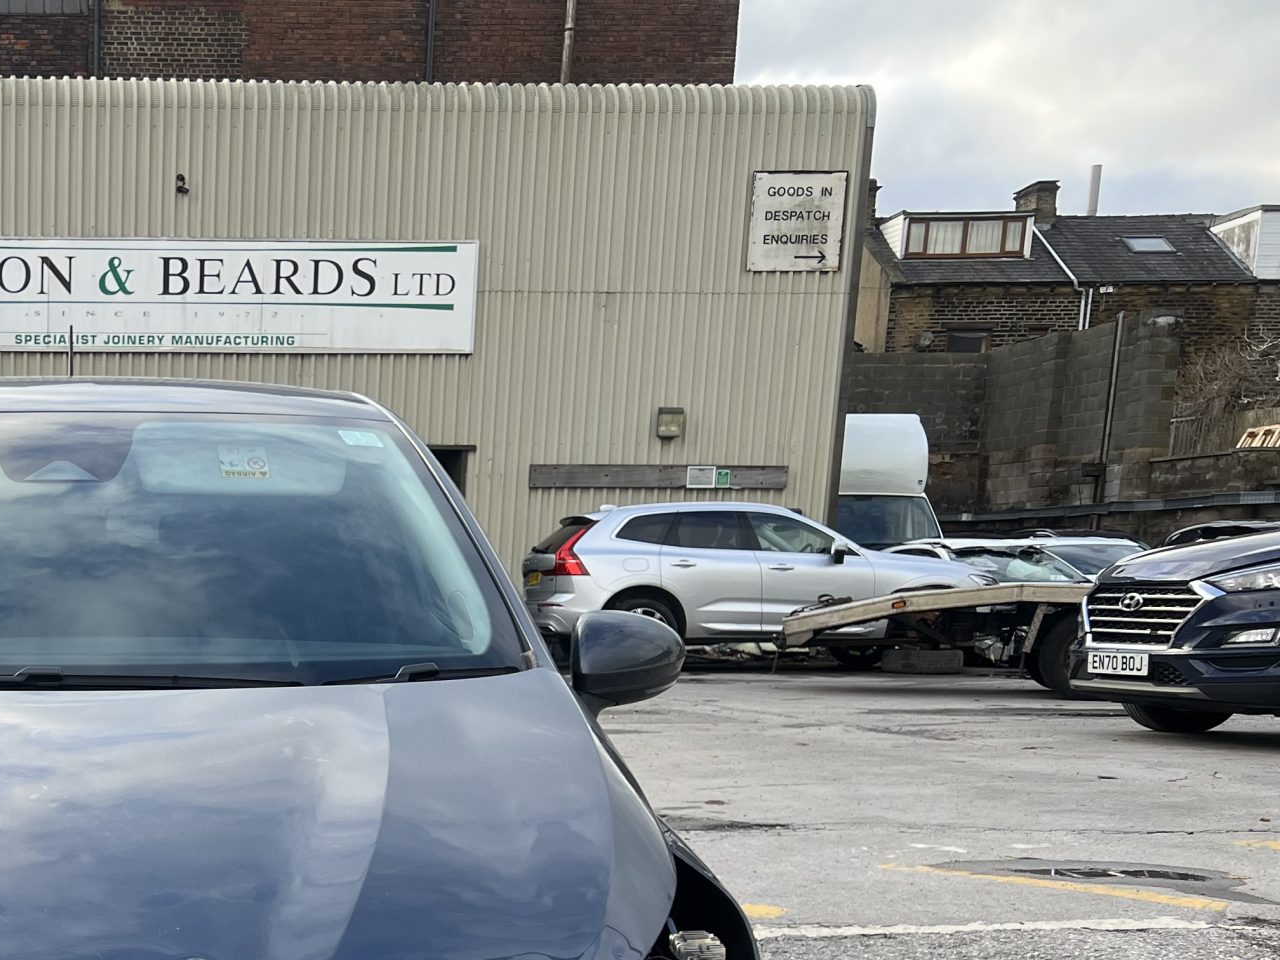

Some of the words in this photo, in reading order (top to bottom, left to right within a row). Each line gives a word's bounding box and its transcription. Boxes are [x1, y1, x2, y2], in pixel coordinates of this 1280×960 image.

[767, 186, 814, 197] GOODS
[821, 186, 833, 197] IN
[764, 210, 831, 221] DESPATCH
[762, 233, 828, 245] ENQUIRIES
[98, 256, 136, 296] &
[157, 256, 378, 297] BEARDS
[391, 272, 457, 297] LTD
[33, 309, 151, 318] SINCE
[193, 310, 279, 319] 1972
[14, 333, 98, 346] SPECIAIST
[103, 334, 166, 346] JOINERY
[171, 334, 296, 347] MANUFACTURING
[224, 470, 257, 478] AIRBAG
[1092, 654, 1119, 671] EN70
[1121, 655, 1143, 672] BOJ
